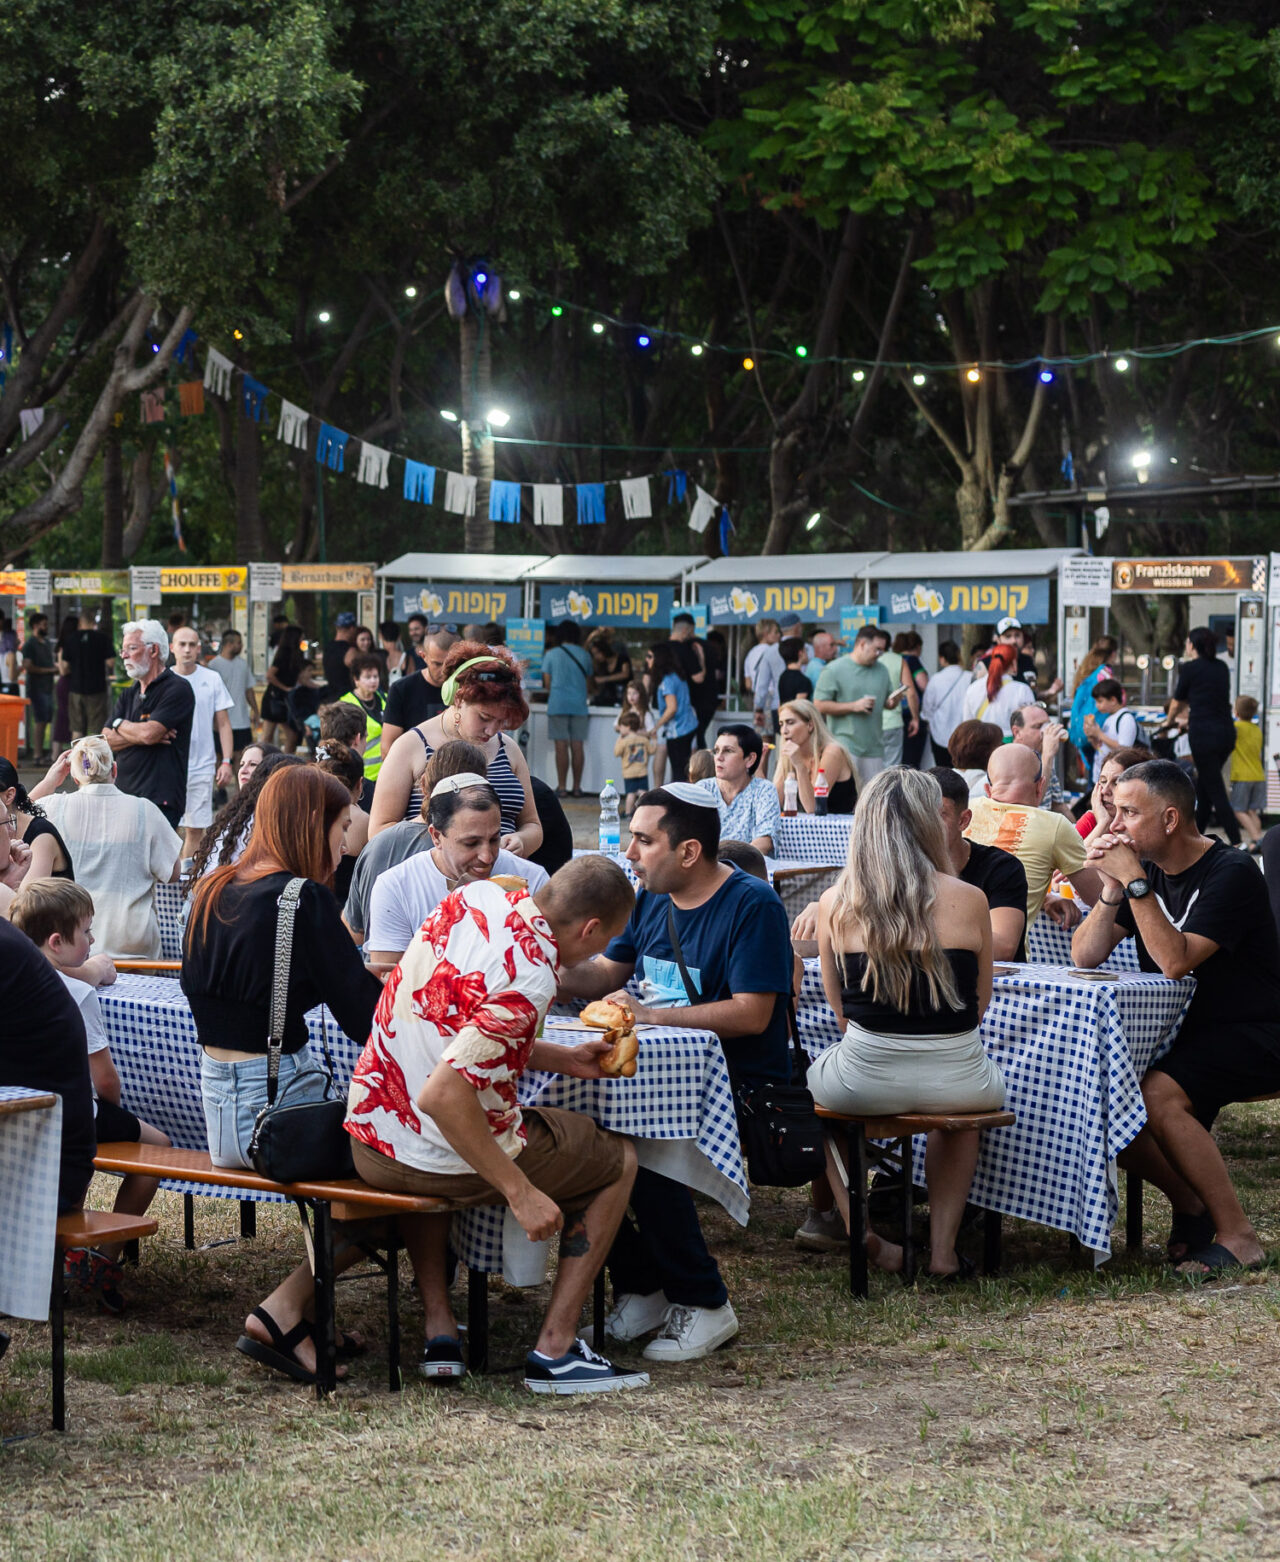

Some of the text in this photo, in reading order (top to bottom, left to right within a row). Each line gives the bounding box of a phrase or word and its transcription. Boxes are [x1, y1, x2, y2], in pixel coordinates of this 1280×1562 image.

[160, 573, 222, 587] CHOUFFE
[1135, 563, 1212, 578] Franziskaner
[1152, 577, 1194, 587] WEISSBIER
[446, 591, 507, 622] קופות
[596, 592, 659, 623] קופות
[763, 585, 836, 618] קופות
[949, 585, 1029, 618] קופות
